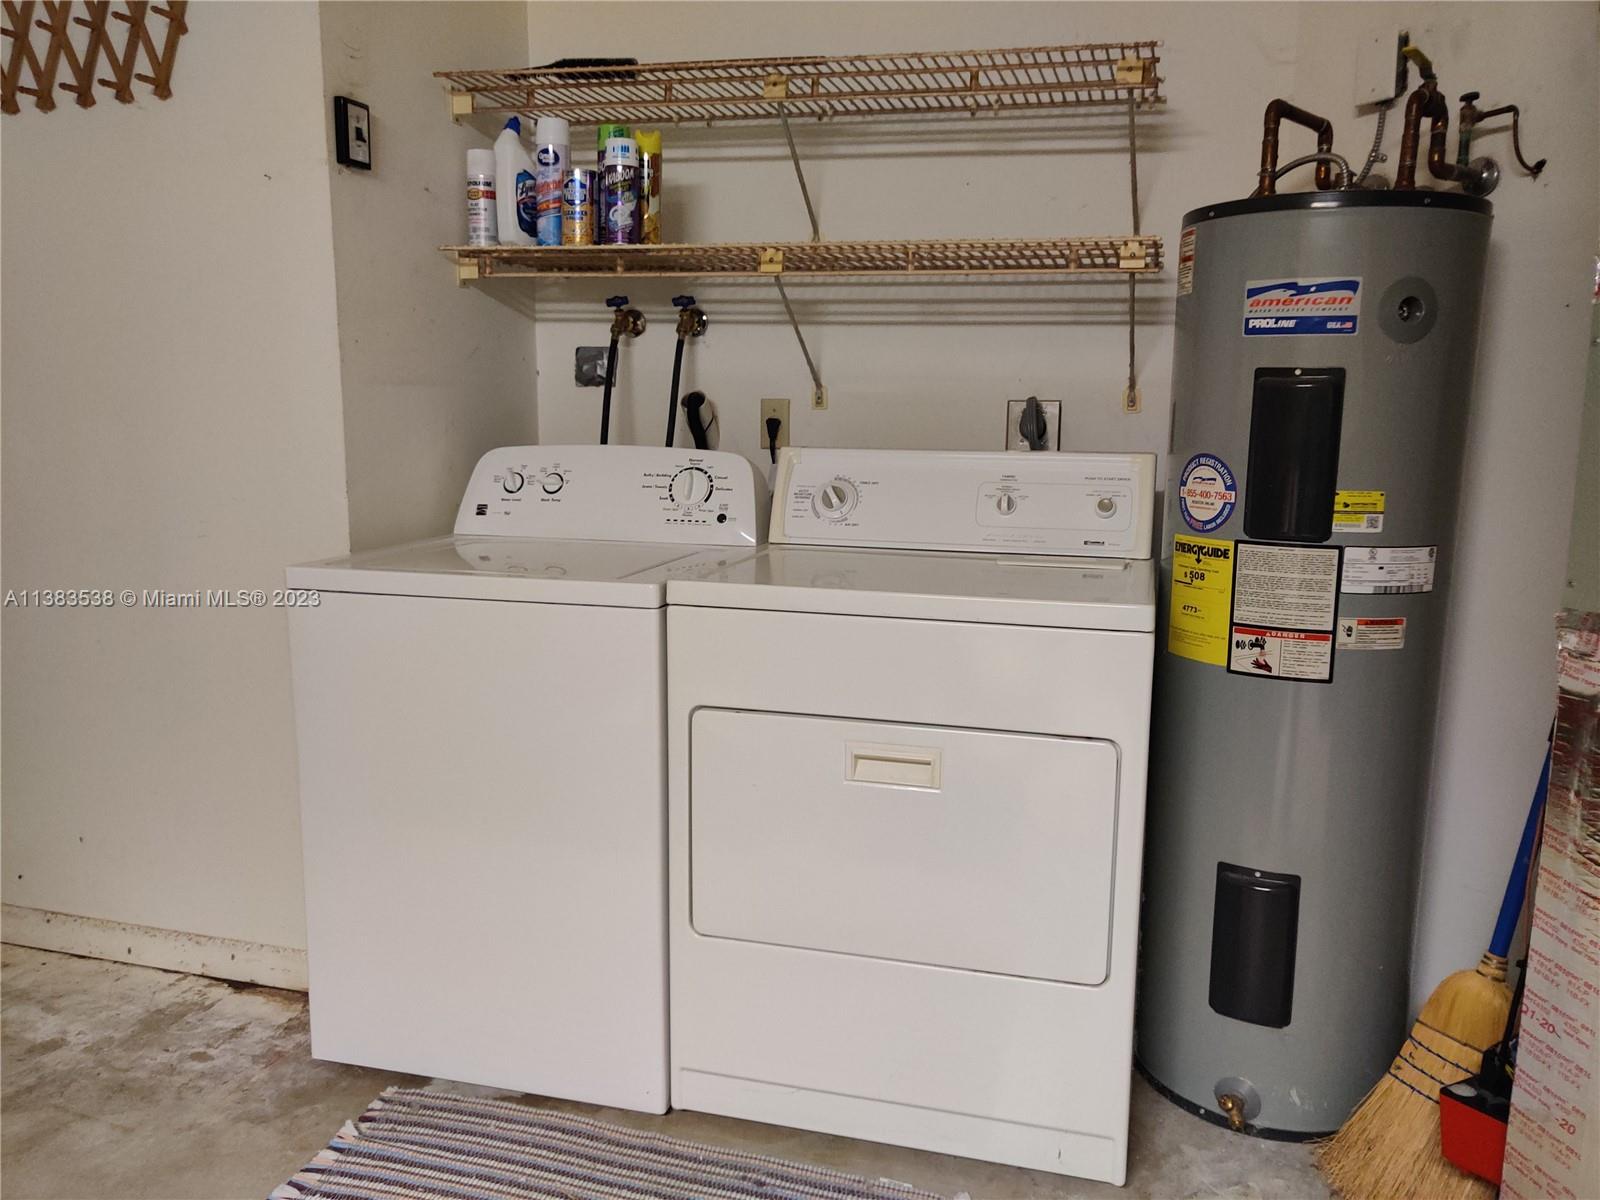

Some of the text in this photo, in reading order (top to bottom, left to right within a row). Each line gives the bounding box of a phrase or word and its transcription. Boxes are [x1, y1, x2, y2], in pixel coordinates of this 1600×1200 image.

[1248, 295, 1354, 308] american
[1199, 456, 1233, 486] REGISTRATION
[1181, 487, 1233, 501] 1-855-400-7563
[1175, 541, 1230, 559] ENERGYGUIDE
[1189, 570, 1206, 581] 508
[1182, 604, 1198, 613] 4773
[1271, 631, 1306, 639] DANGER
